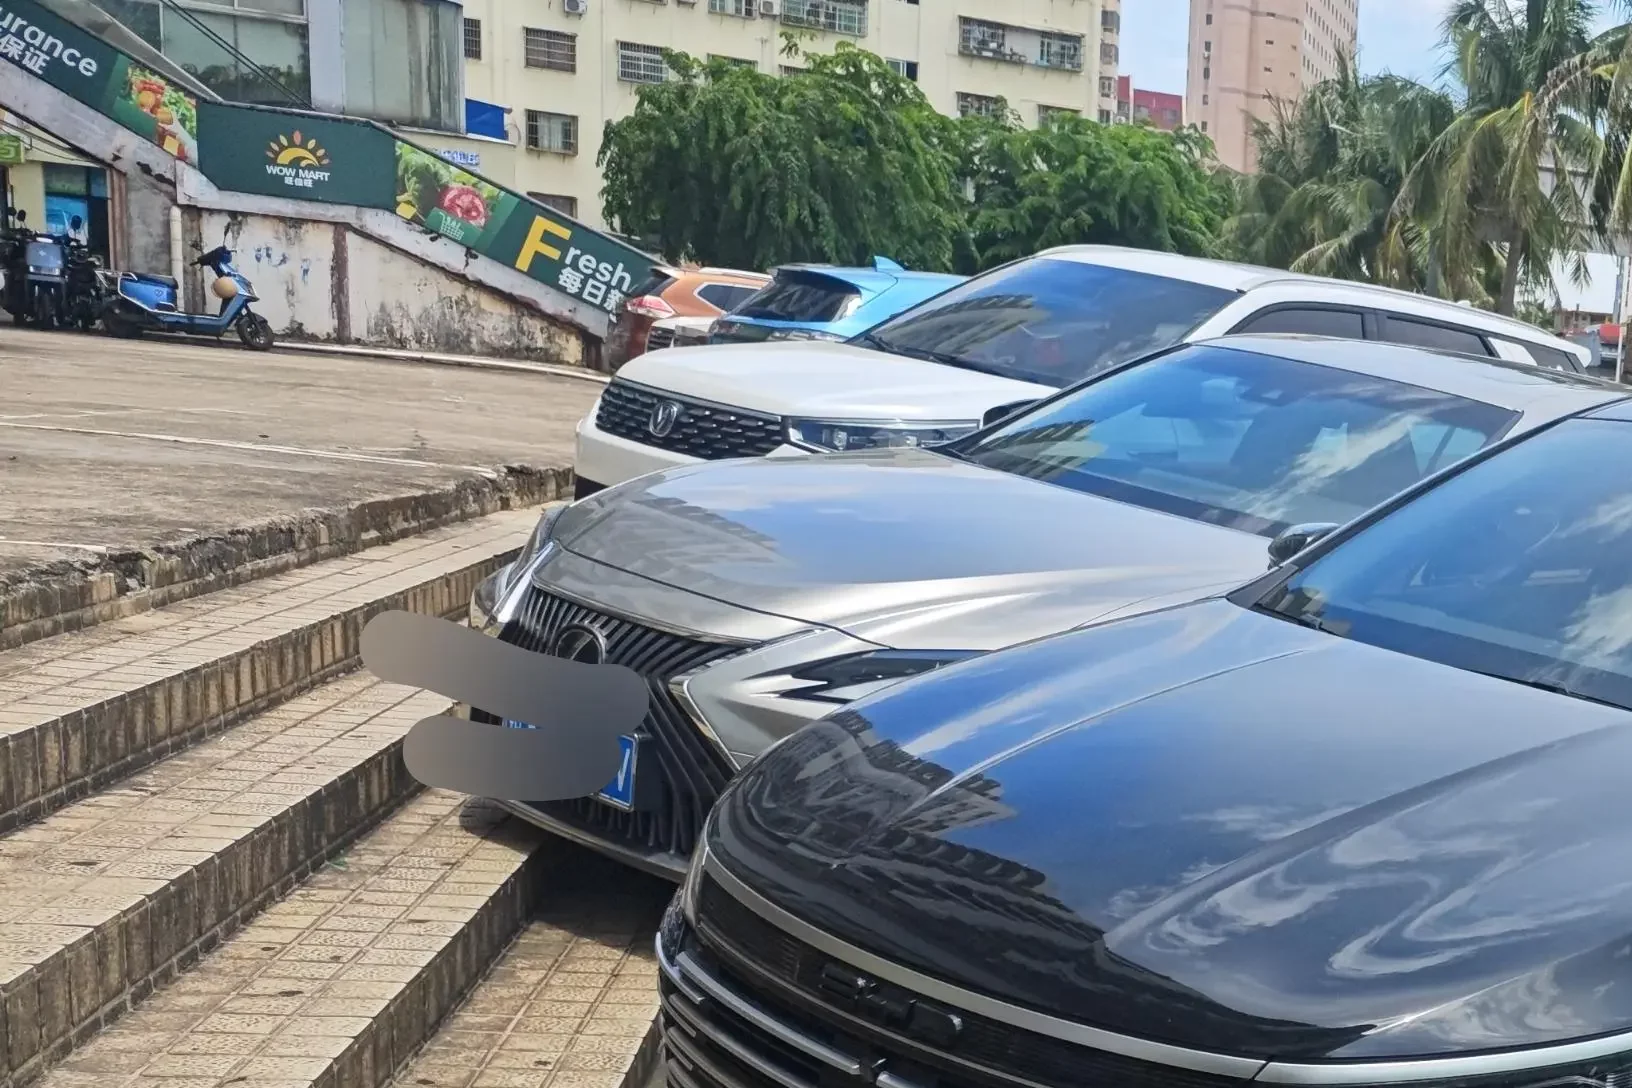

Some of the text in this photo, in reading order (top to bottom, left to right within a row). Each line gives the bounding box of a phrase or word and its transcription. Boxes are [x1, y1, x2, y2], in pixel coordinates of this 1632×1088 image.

[265, 164, 330, 181] WOW MART
[515, 215, 631, 292] Fresh
